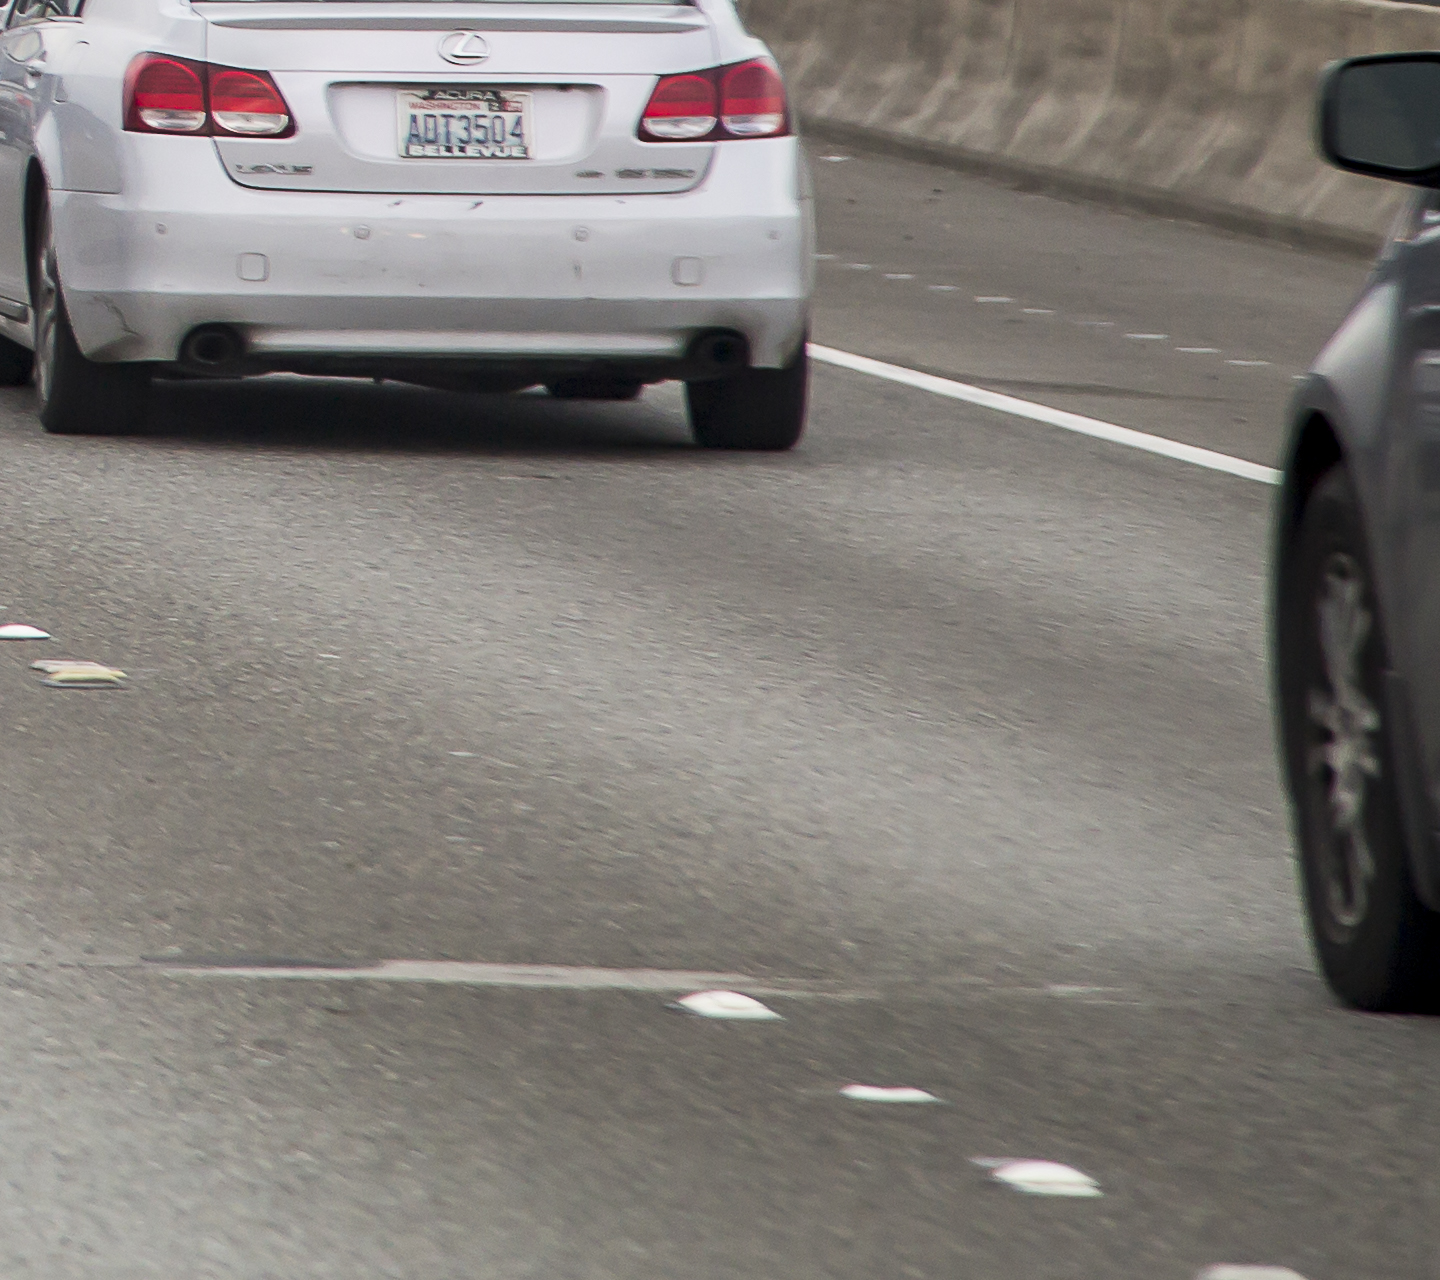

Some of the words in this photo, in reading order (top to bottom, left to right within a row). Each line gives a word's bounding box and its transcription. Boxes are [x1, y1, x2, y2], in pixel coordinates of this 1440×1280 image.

[434, 90, 498, 100] ACURA
[408, 101, 481, 111] WASHINGTON
[408, 113, 524, 144] ADT3504
[407, 144, 529, 157] BELLEVUE
